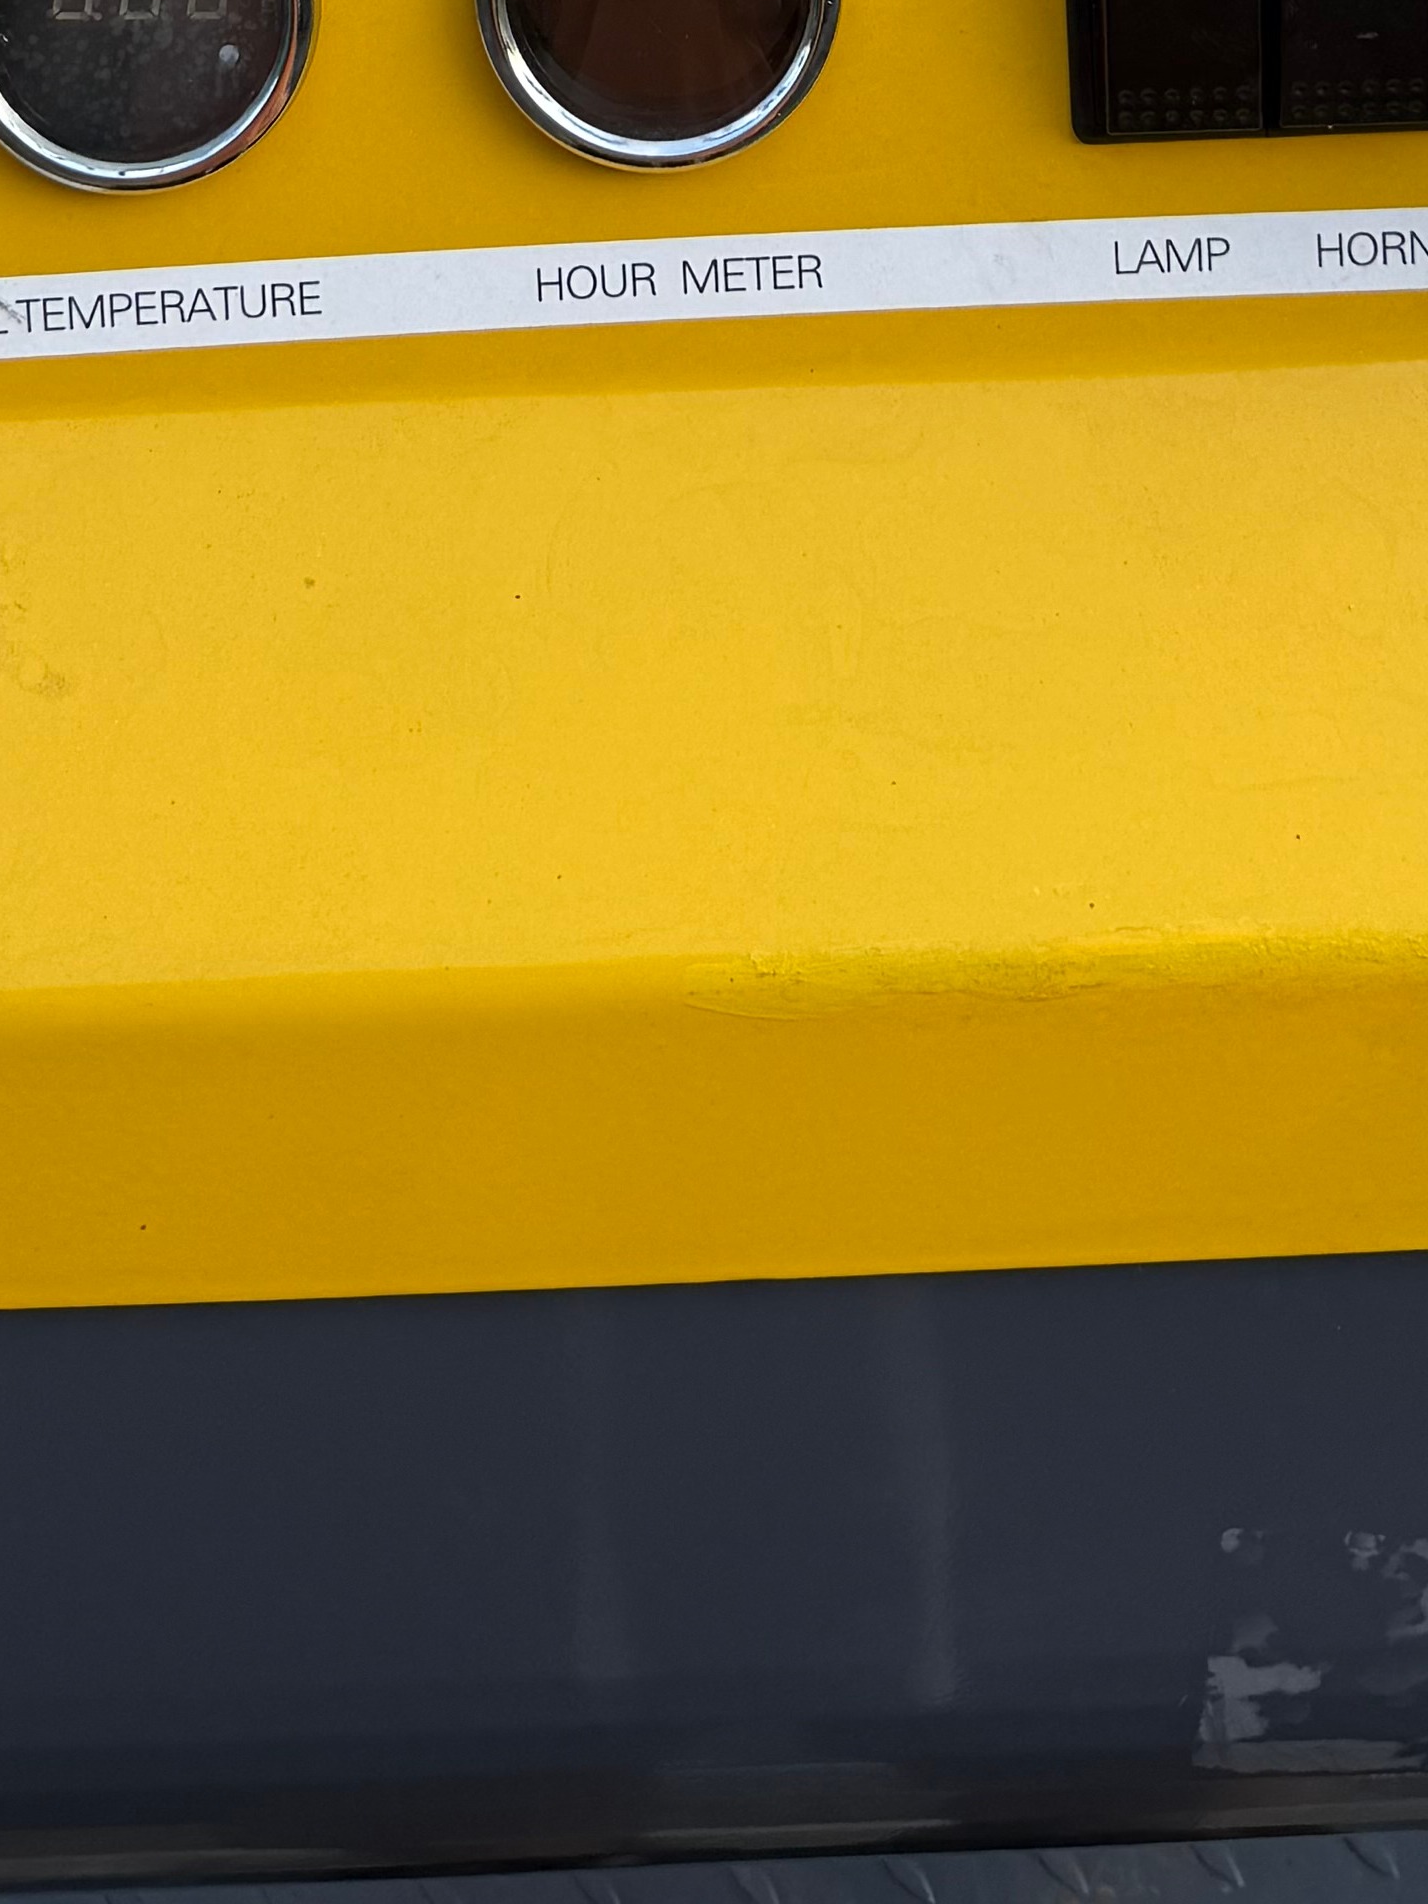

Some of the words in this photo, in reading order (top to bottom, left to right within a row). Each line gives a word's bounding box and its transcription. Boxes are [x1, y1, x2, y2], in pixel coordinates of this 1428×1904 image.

[14, 280, 323, 334] TEMPERATURE
[536, 262, 657, 303] HOUR
[682, 254, 824, 296] METER
[1114, 236, 1232, 276] LAMP
